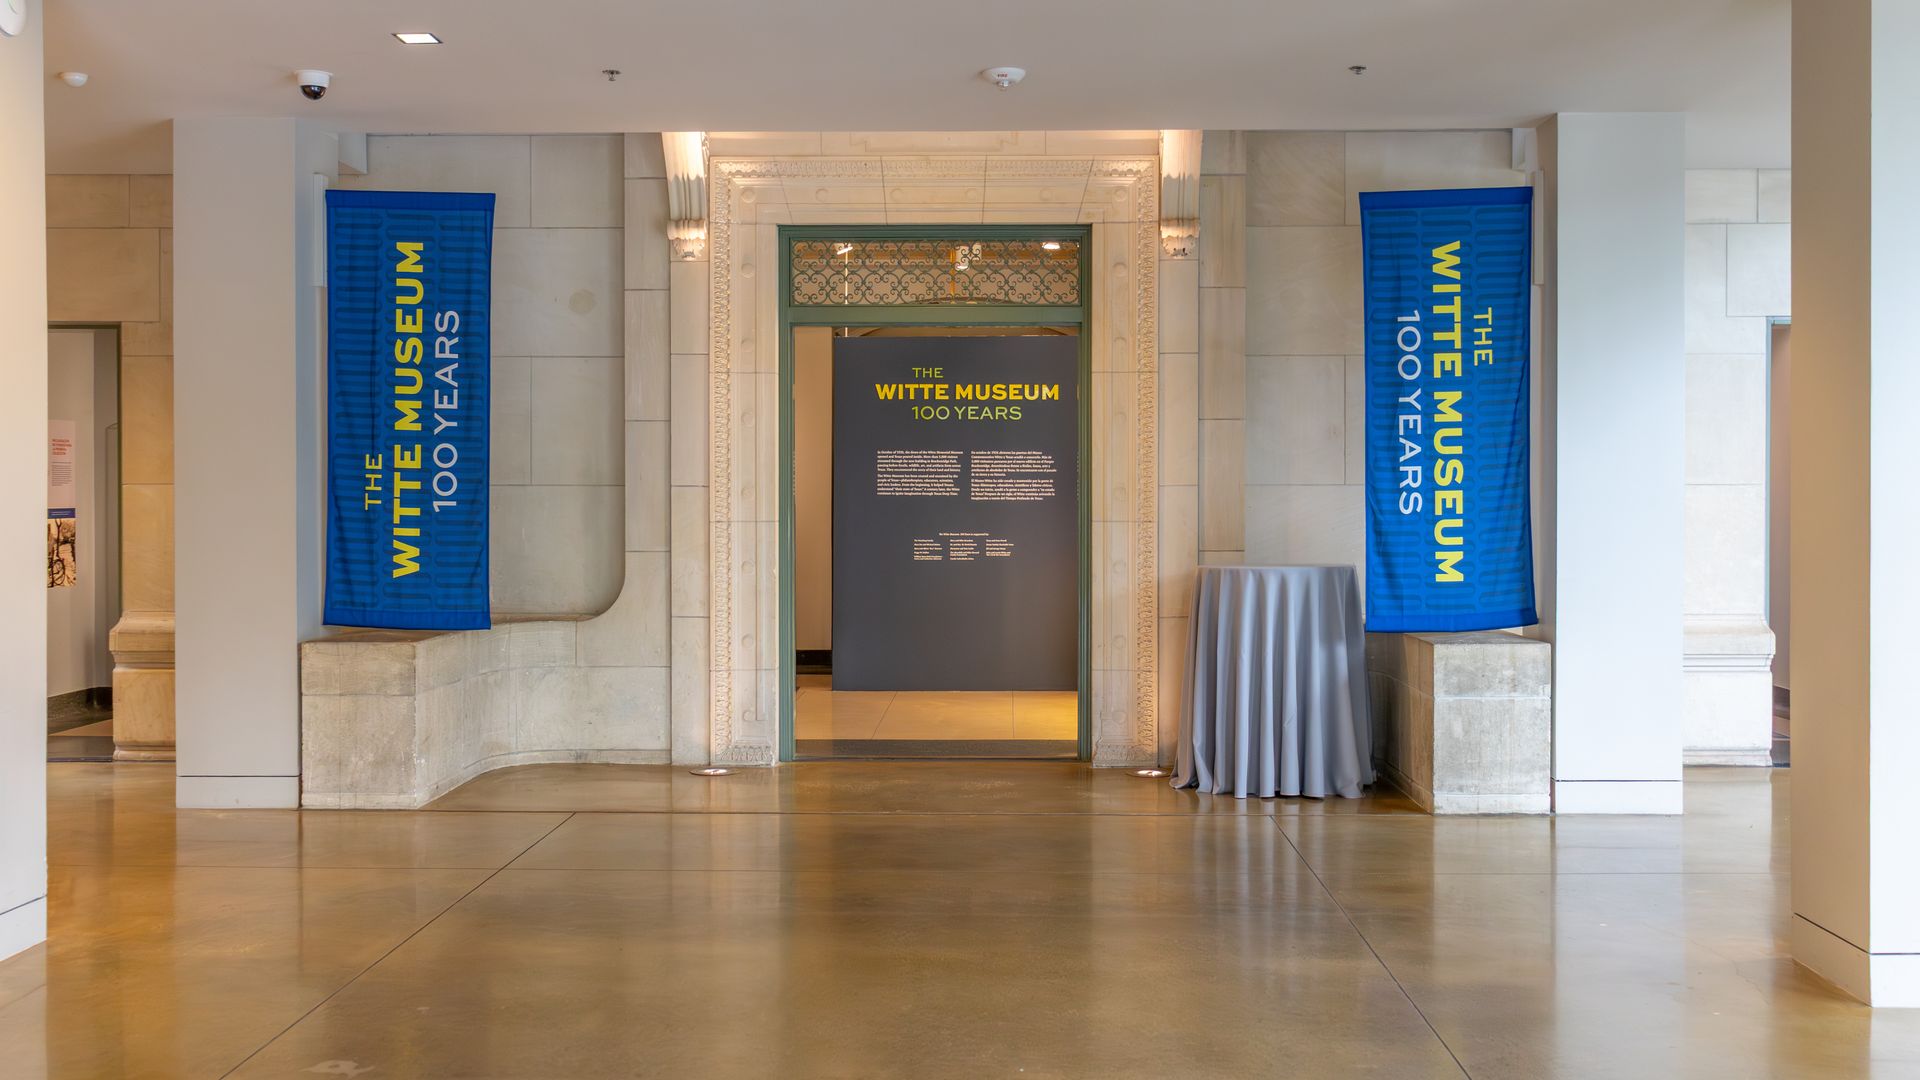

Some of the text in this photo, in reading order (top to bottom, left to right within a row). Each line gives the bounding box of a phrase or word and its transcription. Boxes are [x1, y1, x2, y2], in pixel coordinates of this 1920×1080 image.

[1474, 308, 1492, 366] THE
[875, 383, 1060, 401] WITTE MUSEUM
[912, 367, 944, 378] THE
[393, 242, 423, 578] WITTE MUSEUM
[433, 311, 459, 512] 100 YEARS
[912, 406, 1022, 420] 100 YEARS
[1397, 310, 1422, 514] 100 YEARS
[1432, 240, 1464, 582] WITTE MUSEUM
[365, 454, 382, 510] THE
